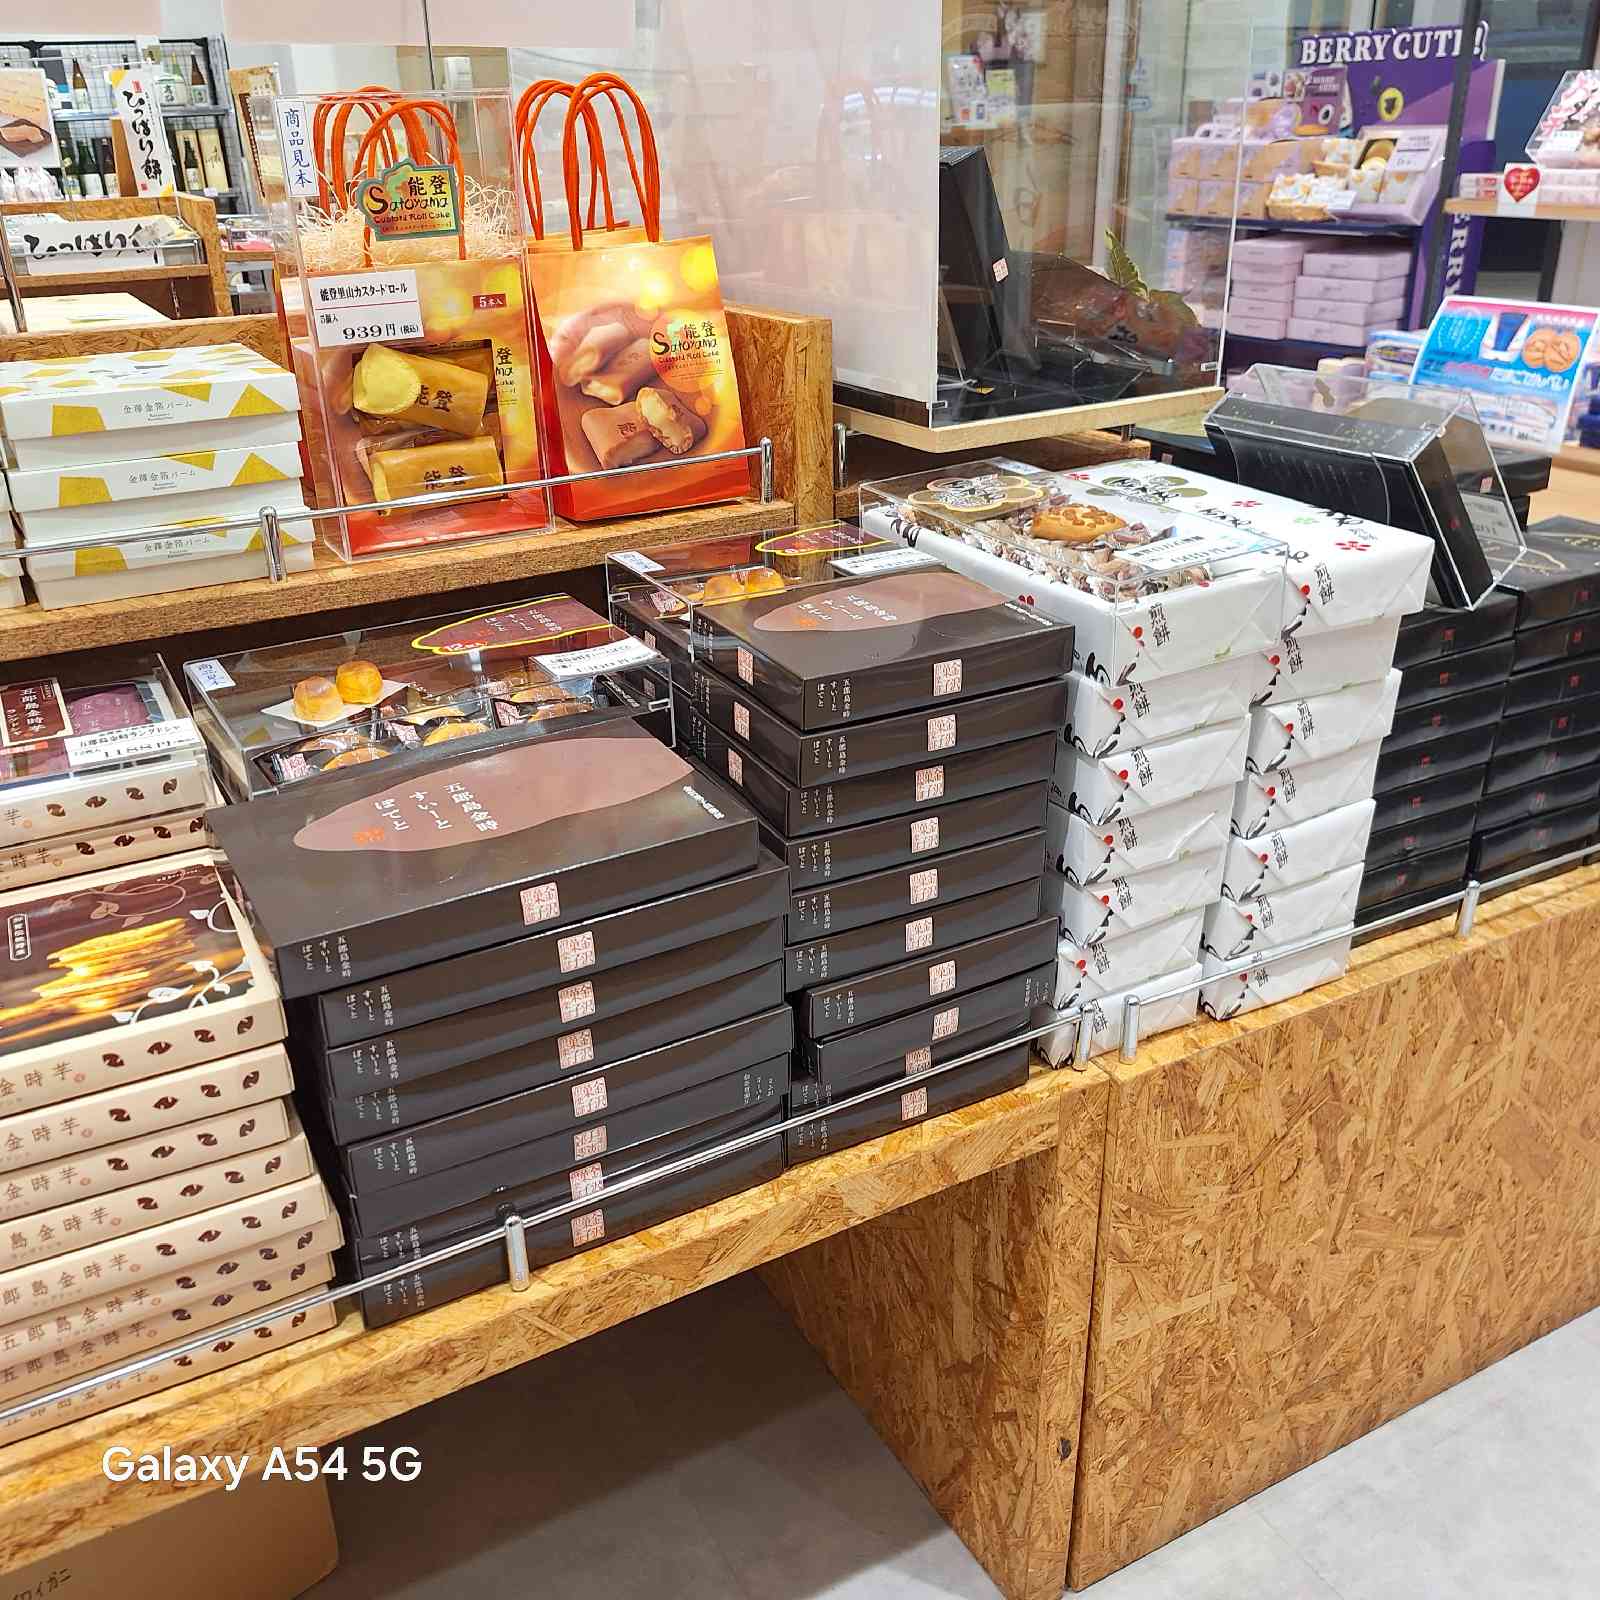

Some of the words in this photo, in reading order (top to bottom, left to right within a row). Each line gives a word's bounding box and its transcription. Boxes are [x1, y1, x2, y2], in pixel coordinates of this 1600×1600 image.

[1300, 35, 1395, 64] BERRY
[284, 110, 313, 188] 商品見本
[366, 186, 448, 214] Satoyama
[408, 175, 448, 195] 能登
[320, 283, 408, 301] 能登里山カスタードロール
[343, 324, 396, 339] 939円
[652, 332, 717, 355] Satoyama
[684, 322, 716, 339] 能登
[409, 791, 453, 830] すいーと
[443, 783, 499, 832] 五郎島金時
[0, 1060, 73, 1097] 金時芋
[5, 1116, 80, 1151] 金時芋
[5, 1166, 79, 1201] 金時芋
[10, 1207, 109, 1250] 島金時芋
[2, 1253, 128, 1306] 郎島金時芋
[2, 1288, 149, 1351] 五郎島金時芋
[1, 1321, 145, 1384] 五郎島金時芋
